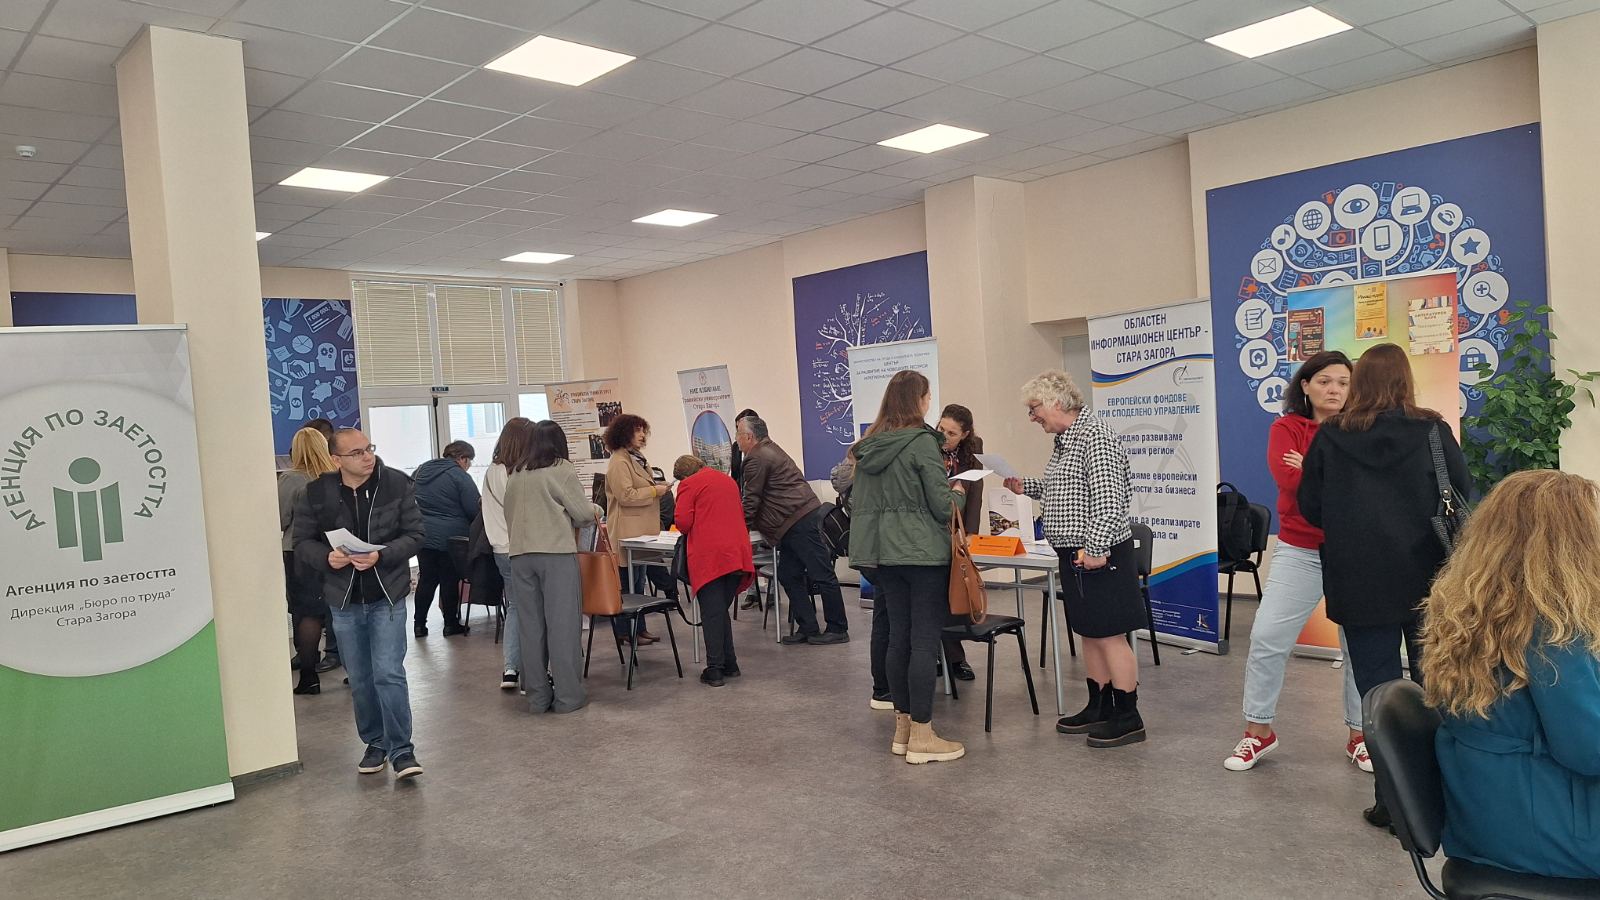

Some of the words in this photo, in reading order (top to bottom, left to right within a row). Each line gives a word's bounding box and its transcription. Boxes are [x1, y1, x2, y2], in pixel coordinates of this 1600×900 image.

[1124, 313, 1167, 330] ОБЛАСТЕН
[1090, 331, 1164, 350] ИНФОРМАЦИОНЕН
[1166, 325, 1201, 342] ЦЕНТЪР
[1116, 350, 1142, 364] СТАРА
[1144, 346, 1176, 361] ЗАГОРА
[1107, 395, 1152, 406] ЕВРОПЕЙСКИ
[1153, 393, 1187, 404] ФОНДОВЕ
[1097, 410, 1111, 418] ПРИ
[1112, 407, 1152, 418] СПОДЕЛЕНО
[1154, 405, 1200, 416] УПРАВЛЕНИЕ
[1141, 433, 1183, 443] развиваме
[1148, 447, 1175, 457] регион
[0, 425, 47, 531] АГЕНЦИЯ
[44, 408, 84, 431] ПО
[93, 409, 167, 519] ЗАЕТОСТТА
[1152, 471, 1198, 482] европейски
[1154, 486, 1163, 494] за
[1165, 484, 1196, 496] бизнеса
[1141, 517, 1150, 525] да
[1151, 517, 1201, 529] реализирате
[1168, 532, 1178, 540] си
[5, 580, 75, 598] Агенция
[79, 576, 99, 589] по
[103, 567, 177, 585] заетостта
[10, 602, 75, 620] Дирекция
[121, 593, 136, 605] по
[56, 614, 93, 627] Стара
[95, 608, 137, 623] Загора
